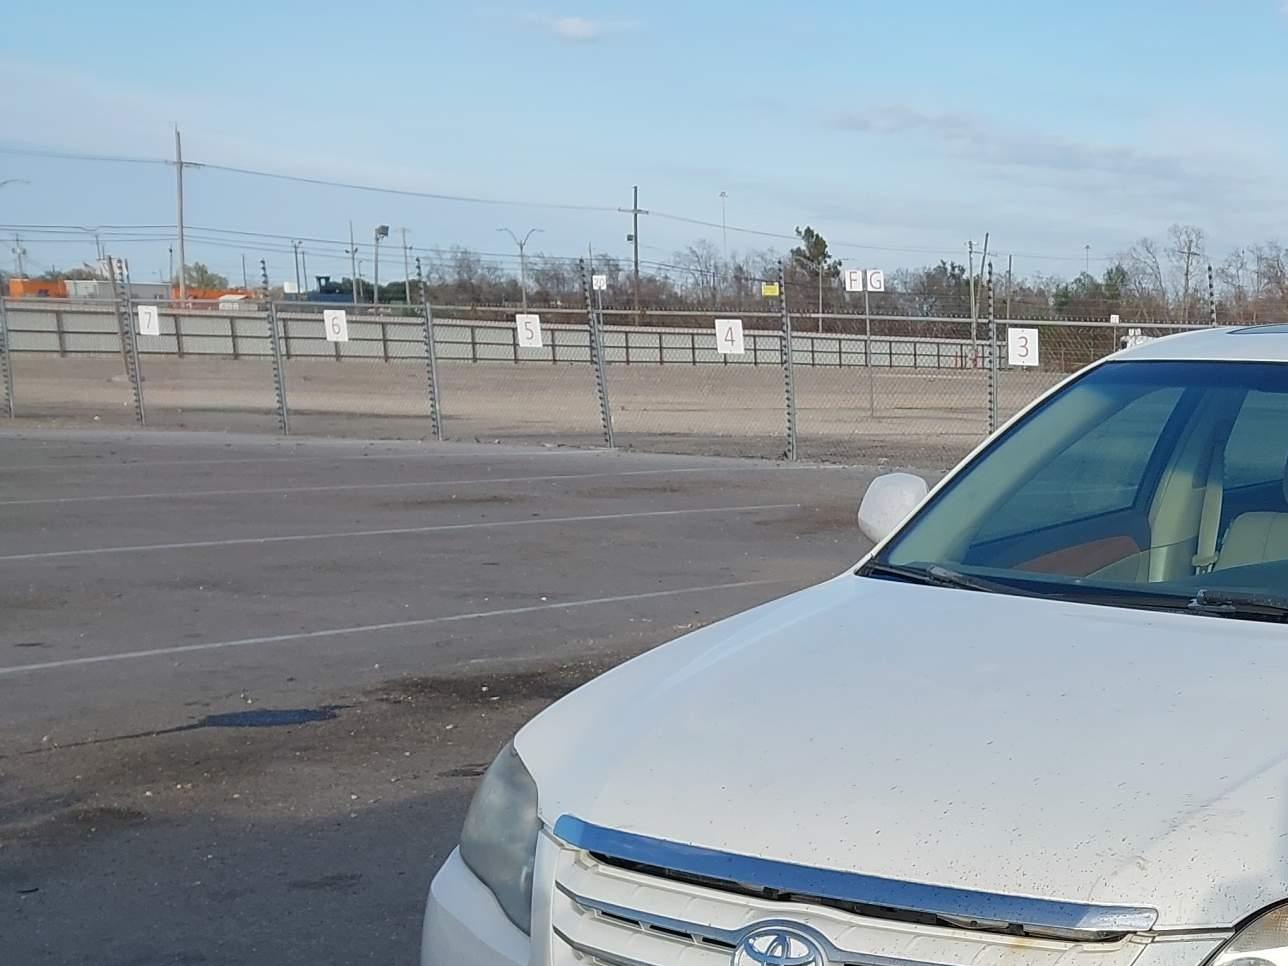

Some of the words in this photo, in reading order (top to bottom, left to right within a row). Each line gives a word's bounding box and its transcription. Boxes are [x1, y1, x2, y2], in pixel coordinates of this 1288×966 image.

[849, 272, 858, 289] F
[869, 271, 882, 290] G
[143, 311, 153, 330] 7
[331, 316, 343, 336] 6
[522, 320, 536, 341] 5
[723, 326, 737, 347] 4
[1017, 336, 1029, 358] 3
